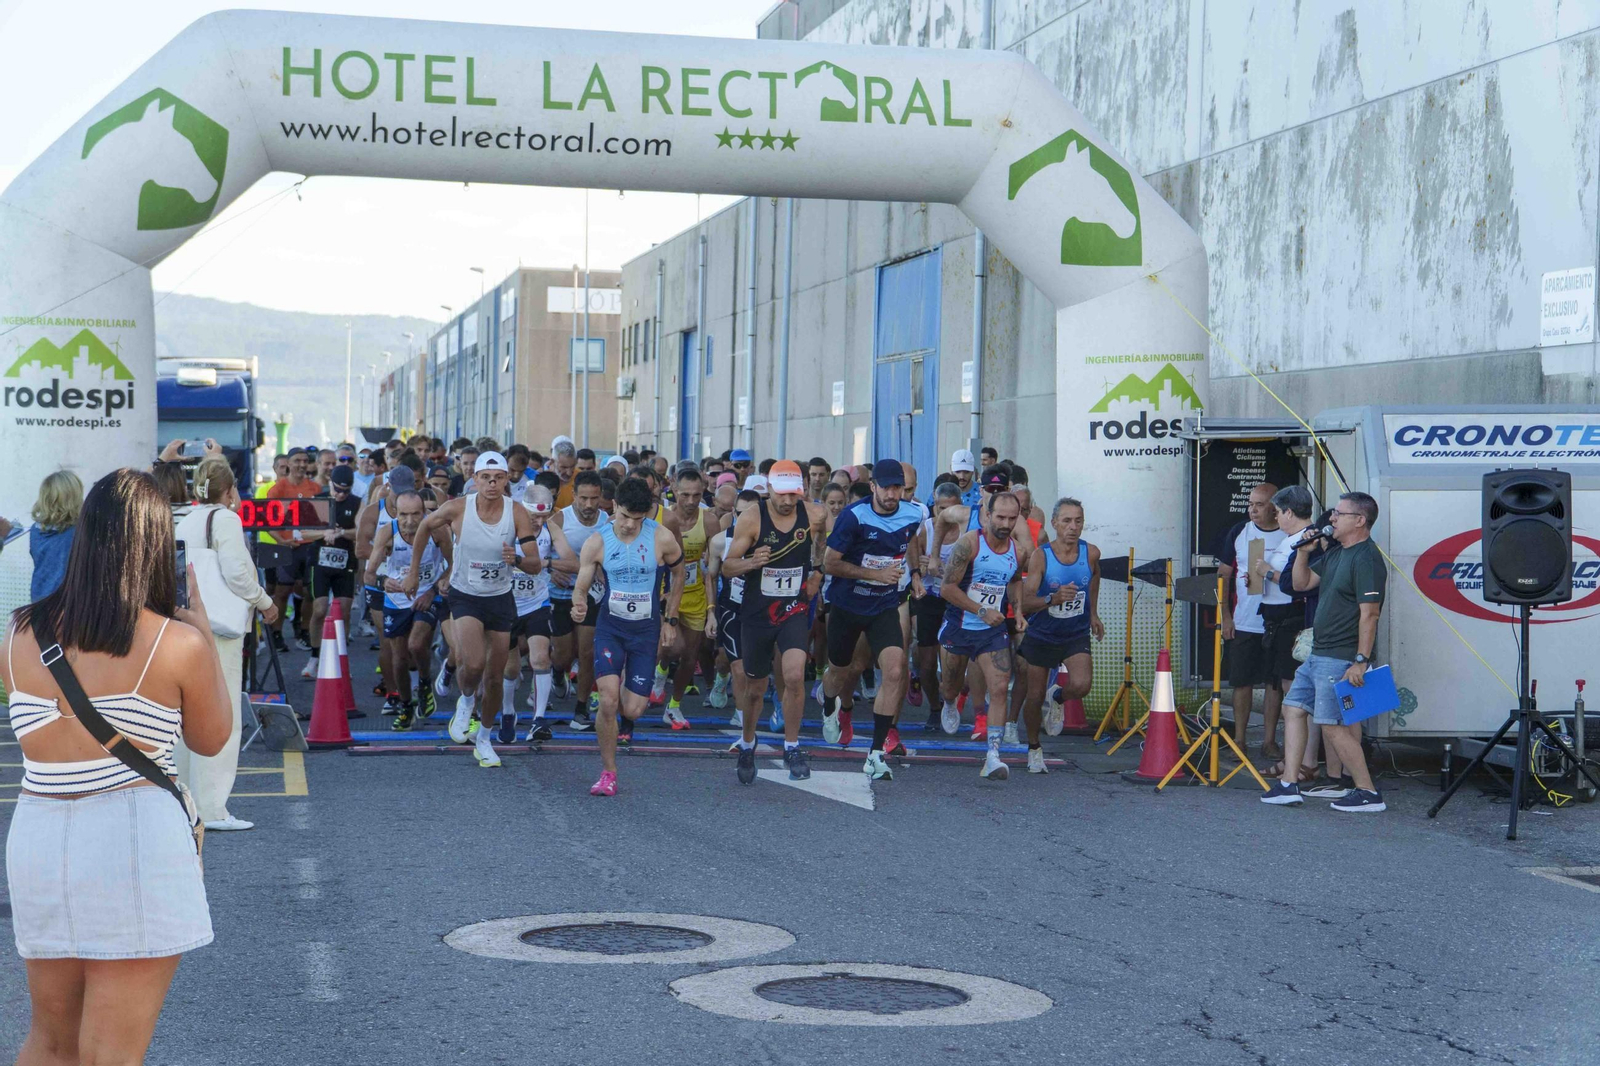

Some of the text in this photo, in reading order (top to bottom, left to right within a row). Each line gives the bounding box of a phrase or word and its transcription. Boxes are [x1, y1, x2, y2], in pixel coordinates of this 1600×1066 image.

[281, 46, 497, 106] HOTEL
[542, 60, 617, 112] LA
[280, 112, 673, 157] www.hotelrectoral.com
[1544, 272, 1593, 294] APARCAMIENTO
[1543, 299, 1579, 319] EXCLUSIVO
[4, 378, 135, 418] rodespi
[15, 415, 122, 430] www.rodespi.es
[1089, 410, 1184, 441] rodes
[1103, 444, 1184, 458] www.rodespi
[1232, 447, 1266, 455] Atletismo
[1411, 450, 1526, 458] CRONOMETRAJE
[325, 554, 345, 564] 109
[480, 569, 500, 580] 23
[510, 579, 534, 591] 158
[775, 577, 793, 589] 11
[979, 593, 997, 605] 70
[626, 602, 637, 613] 6
[1059, 600, 1082, 611] 152
